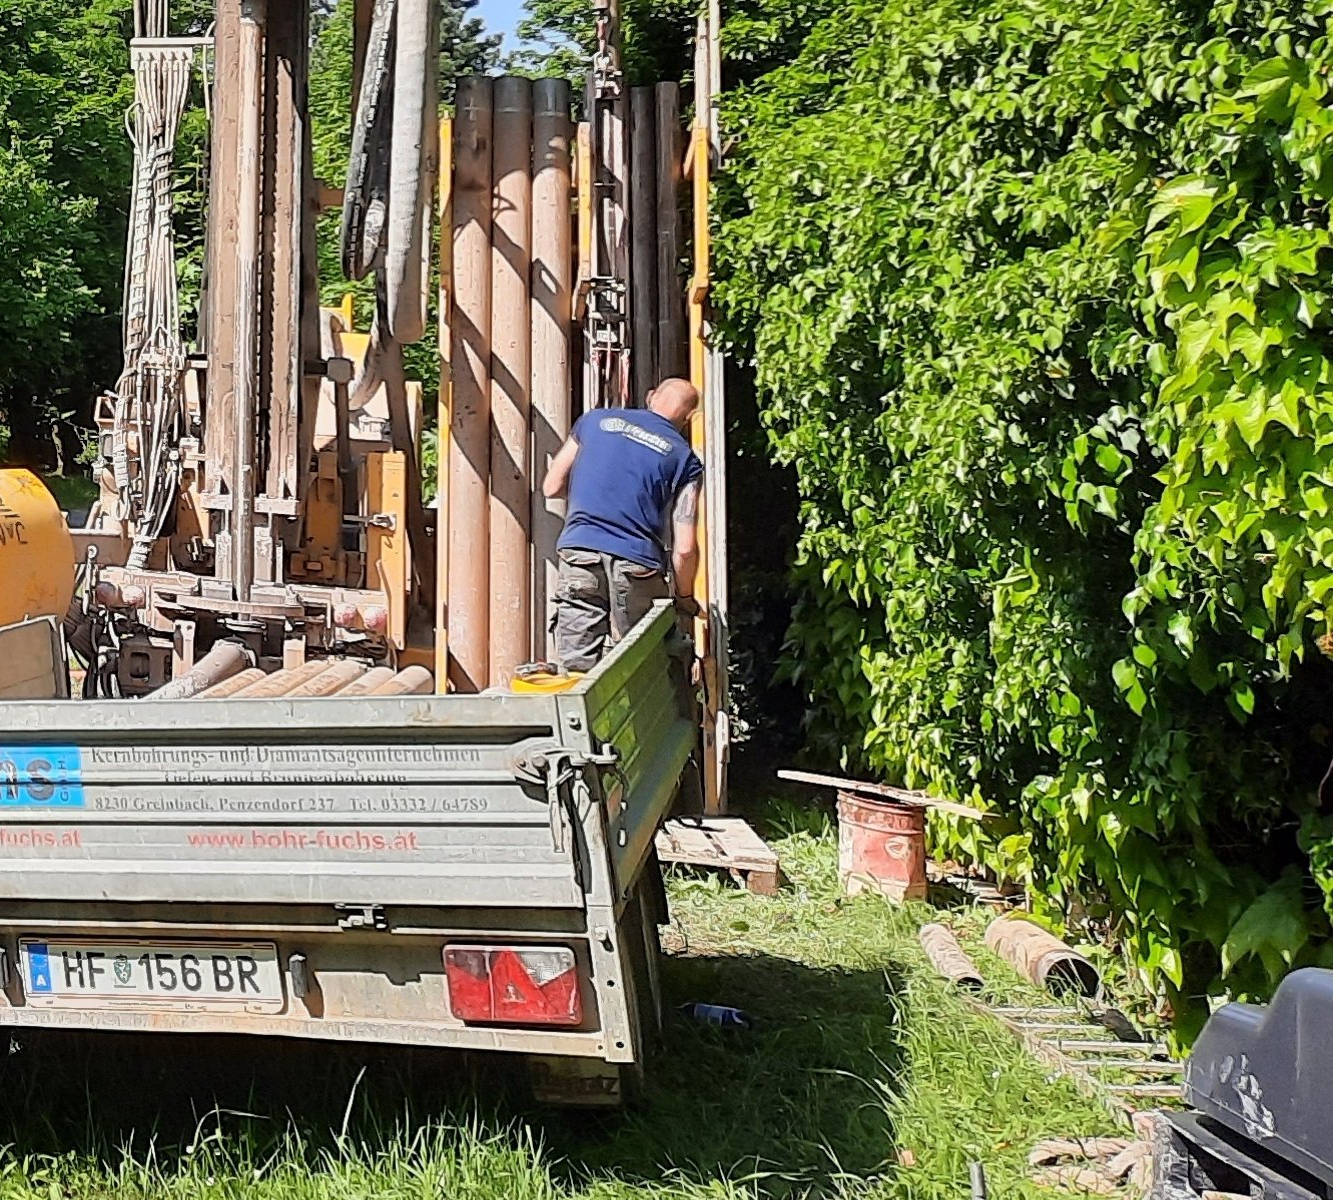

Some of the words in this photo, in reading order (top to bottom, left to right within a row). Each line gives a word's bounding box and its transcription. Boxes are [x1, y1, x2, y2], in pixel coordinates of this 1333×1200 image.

[95, 796, 129, 811] 8230
[309, 797, 335, 811] 237
[187, 829, 418, 850] www.bohr-fuchs.at
[61, 950, 106, 989] HF
[138, 952, 202, 993] 156
[211, 954, 262, 994] BR
